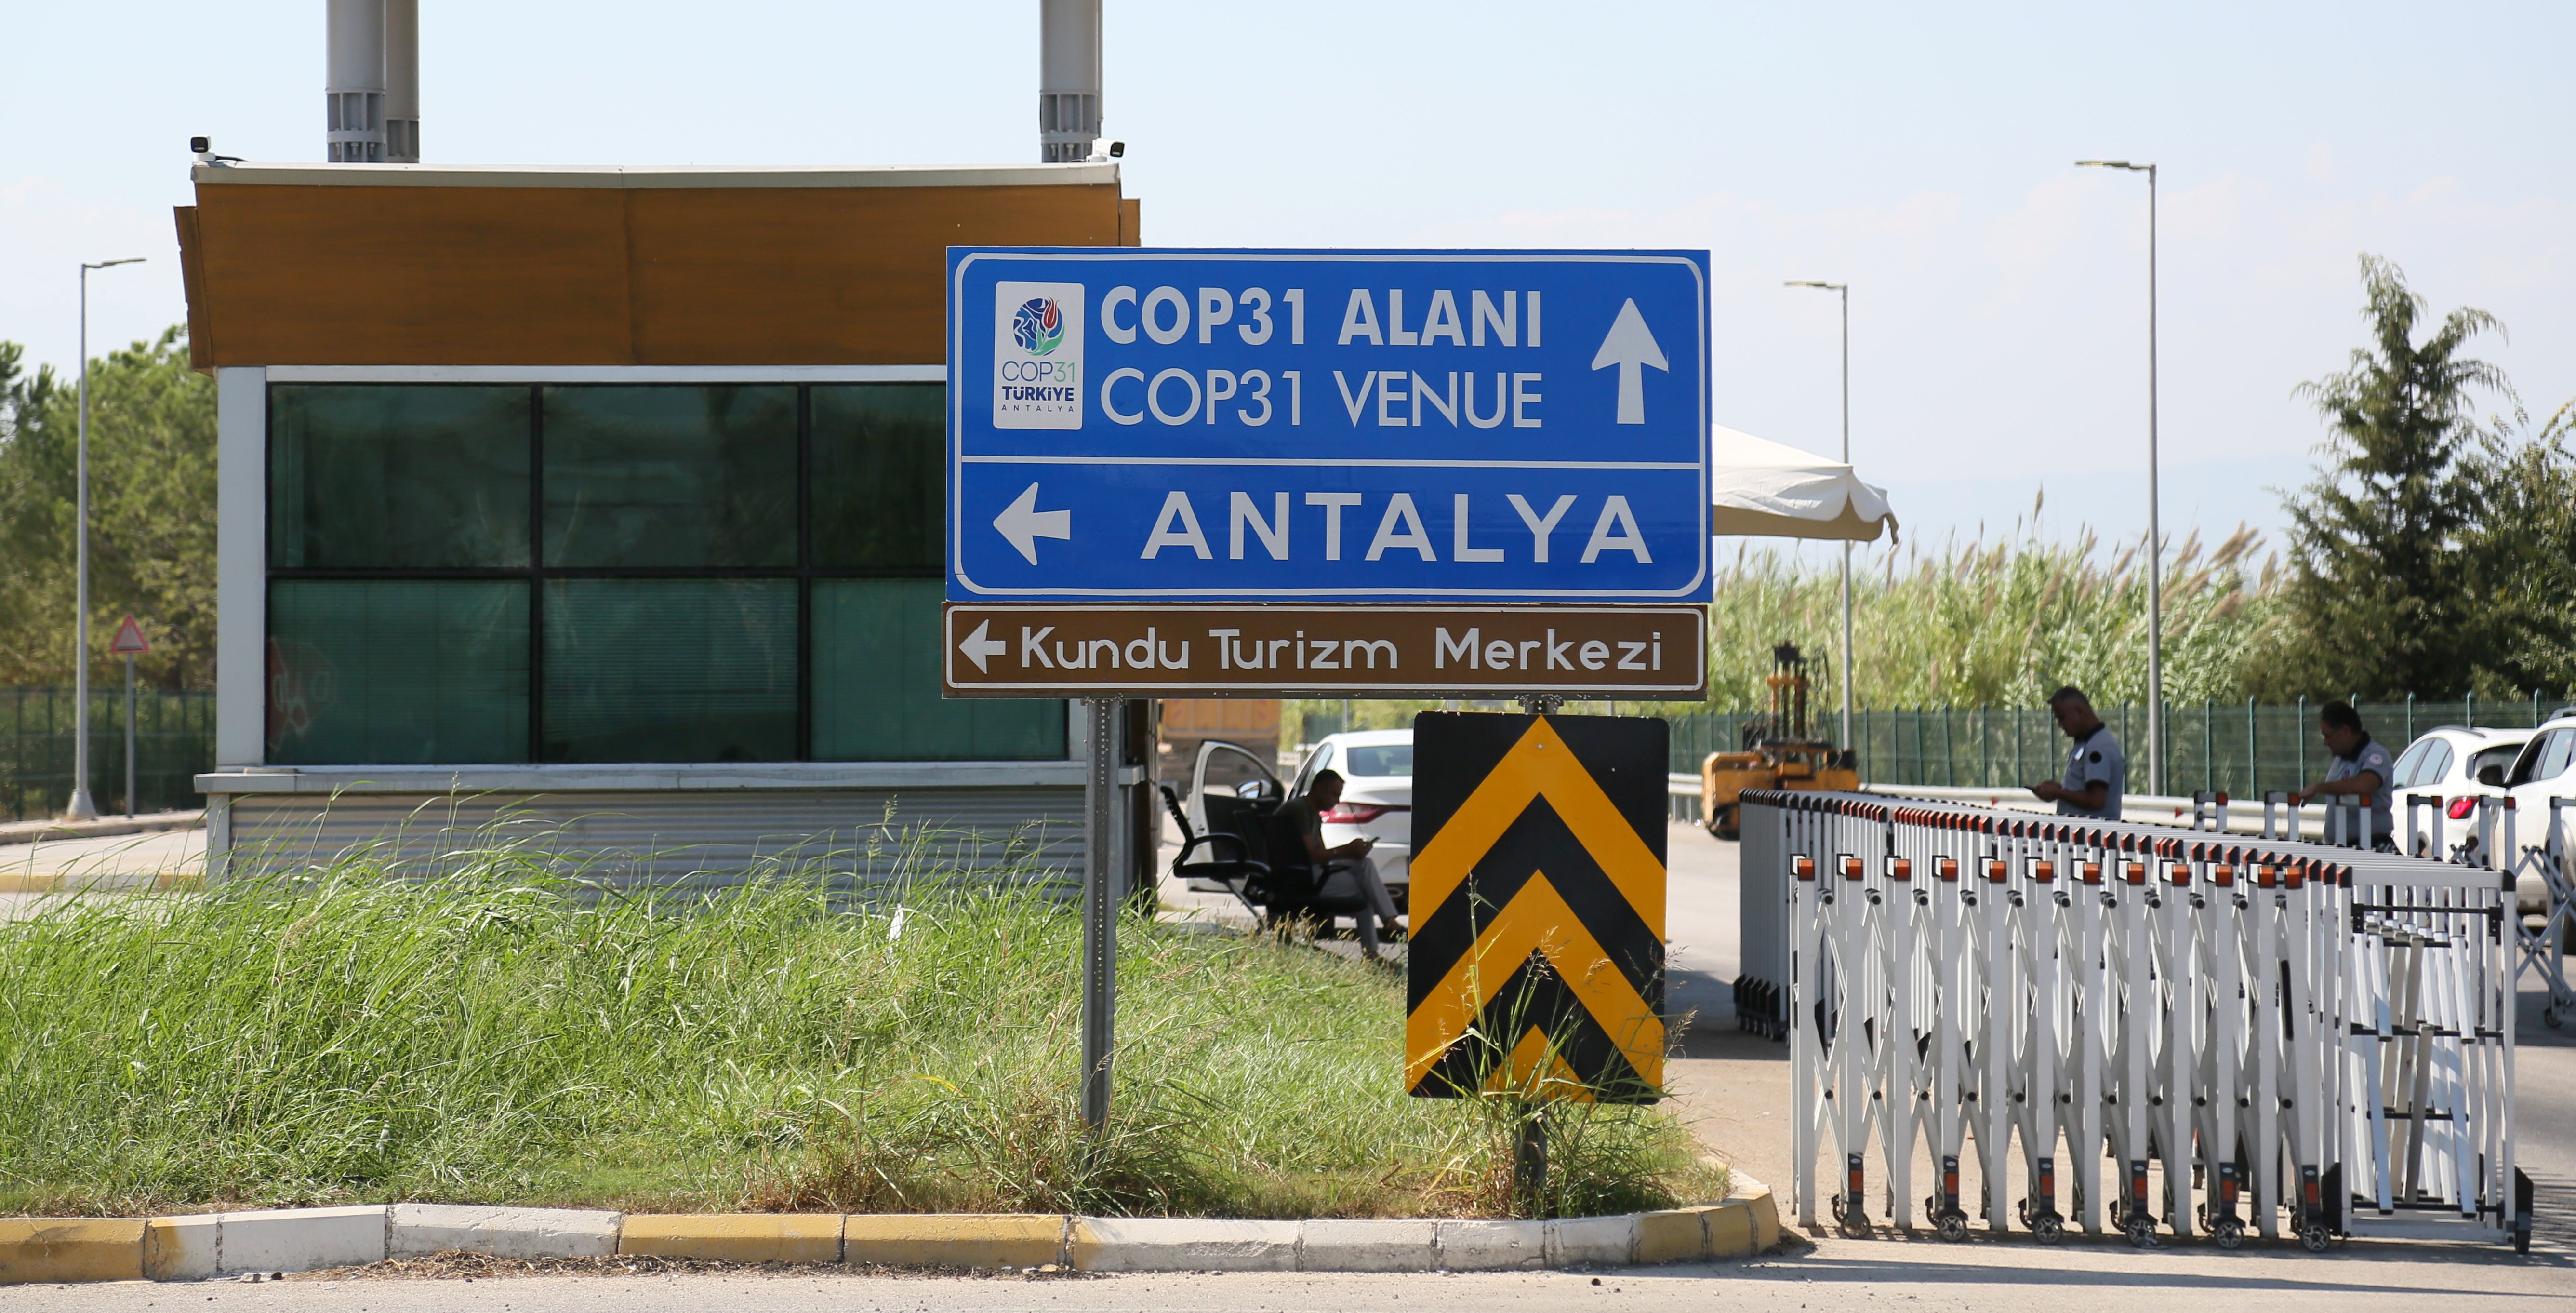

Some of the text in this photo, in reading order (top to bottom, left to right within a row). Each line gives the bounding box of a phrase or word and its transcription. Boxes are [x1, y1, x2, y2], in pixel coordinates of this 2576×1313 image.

[1101, 286, 1540, 347] COP31 ALANI
[1002, 361, 1075, 382] COP31
[1002, 404, 1074, 413] ANTALYA
[1101, 368, 1541, 428] COP31 VENUE
[1141, 492, 1652, 563] ANTALYA
[1022, 627, 1660, 670] Kundu Turizm Merkezi
